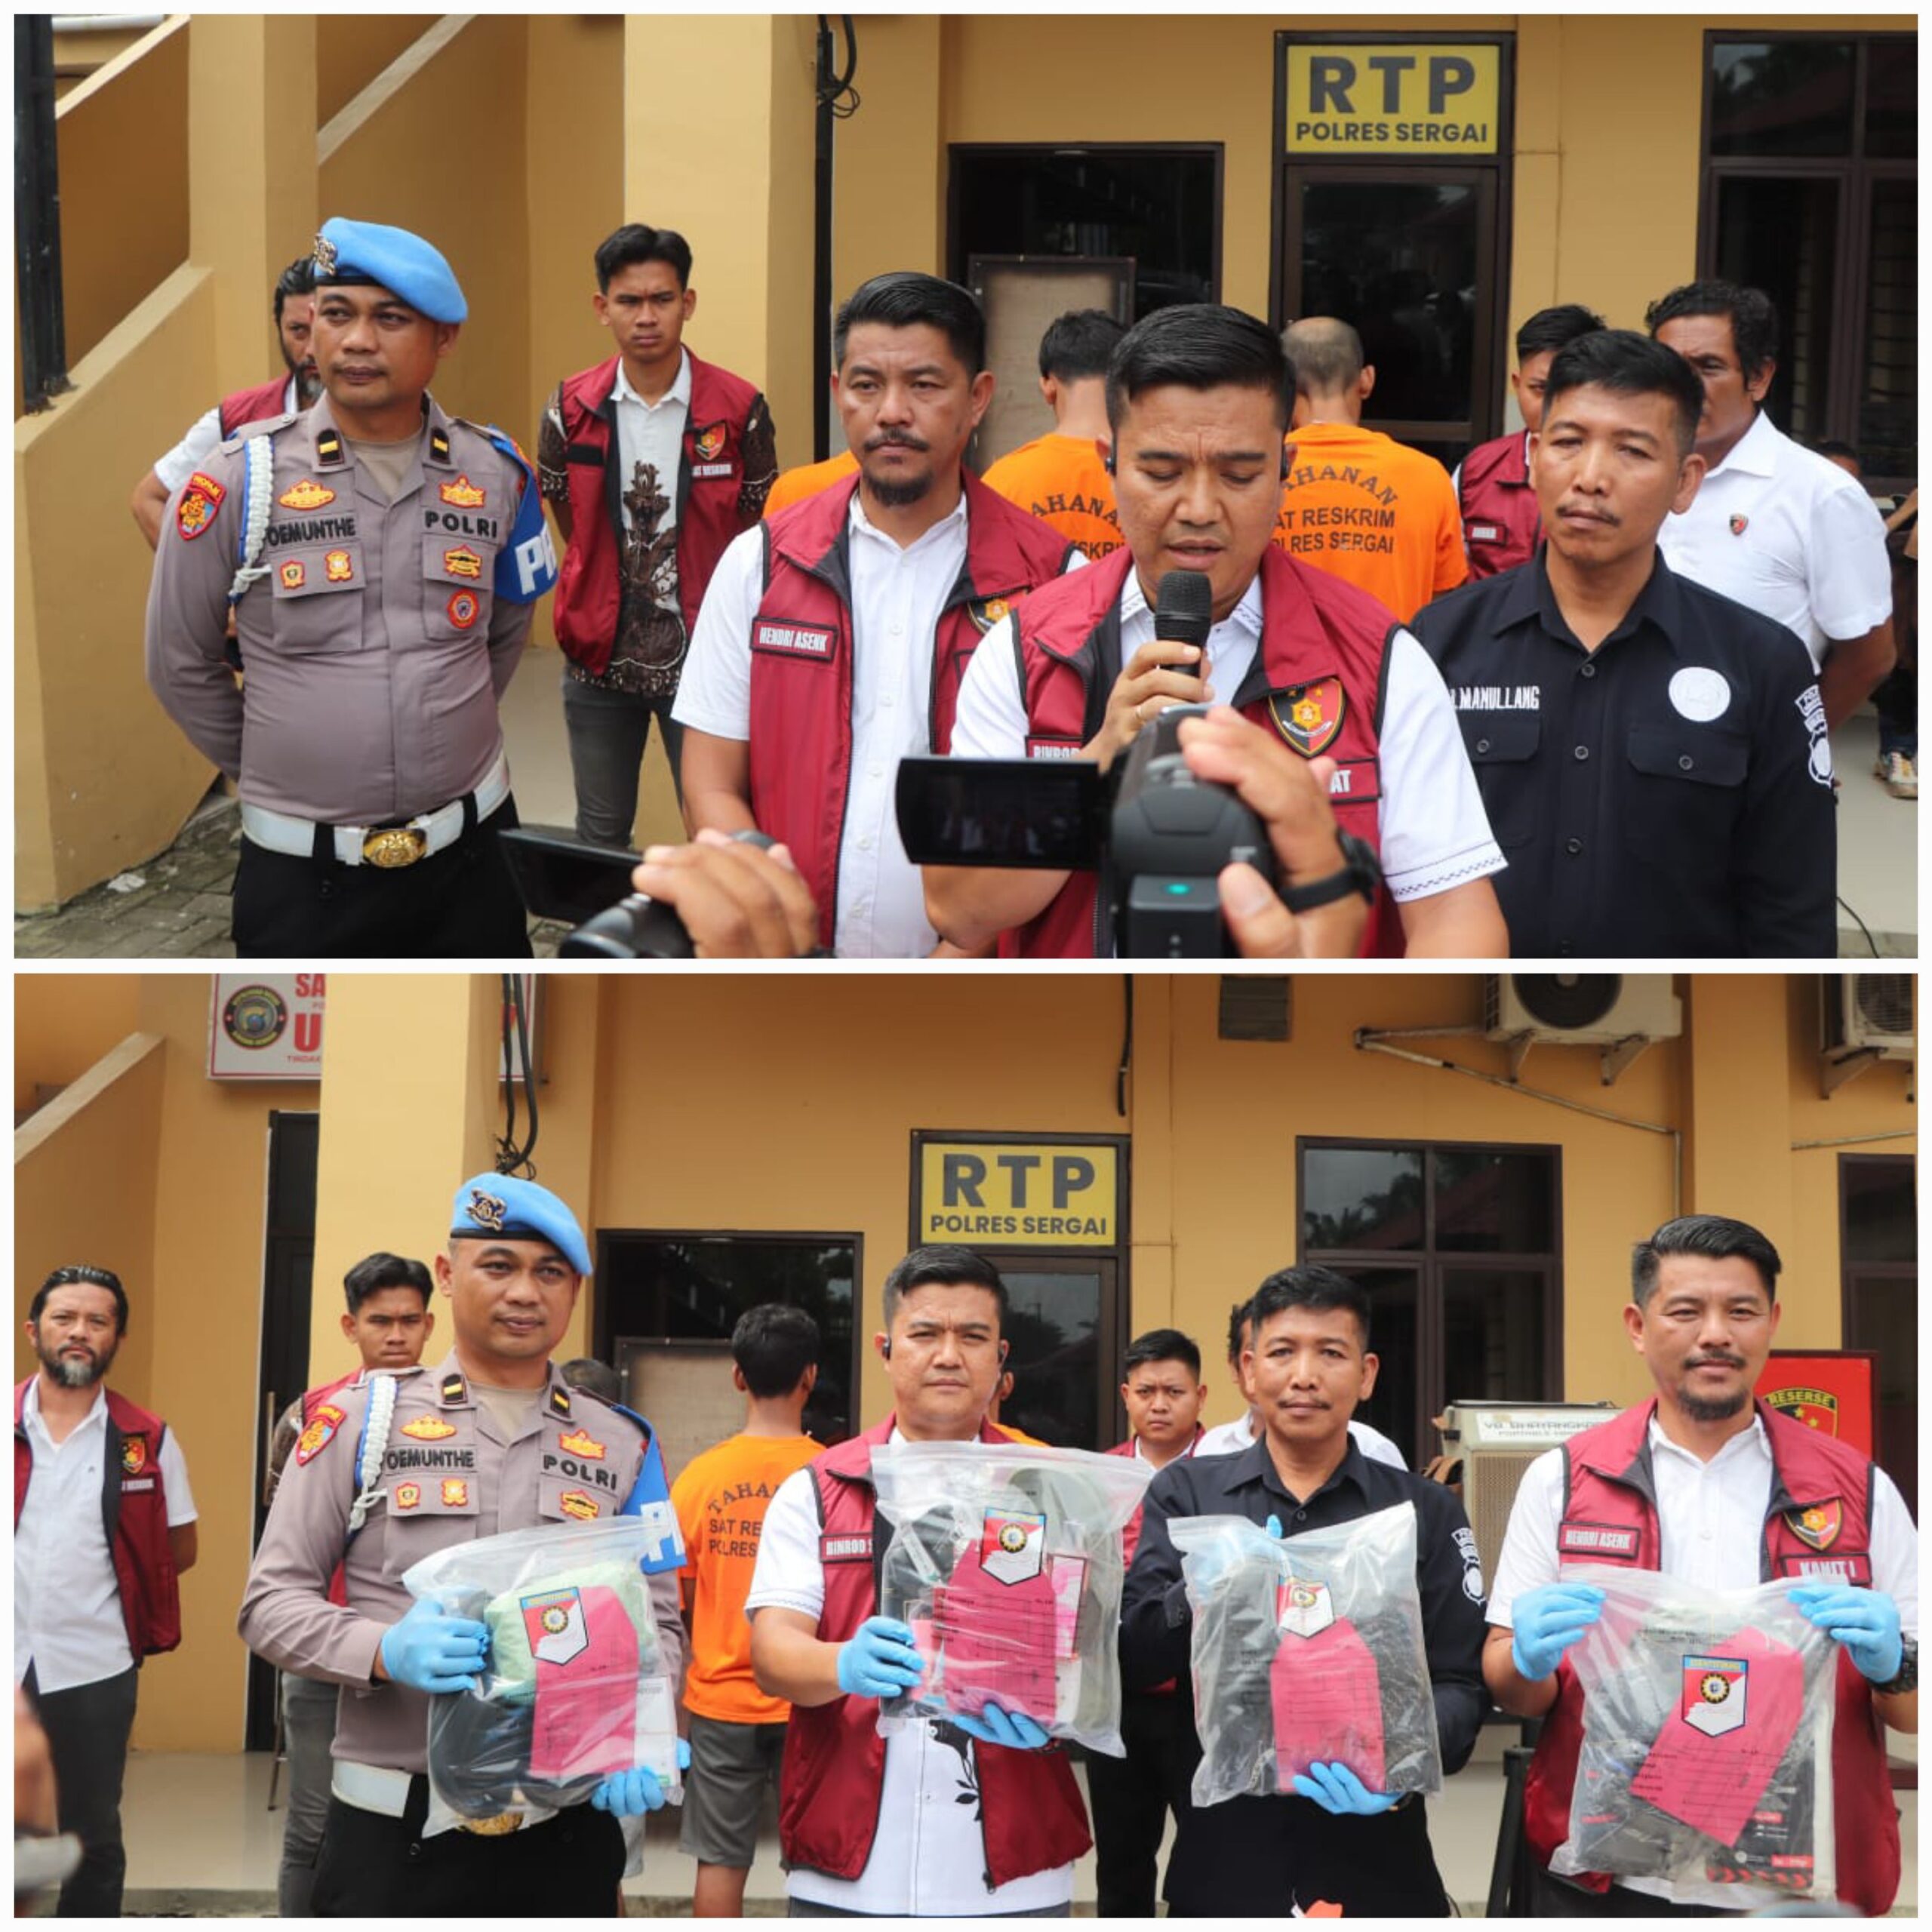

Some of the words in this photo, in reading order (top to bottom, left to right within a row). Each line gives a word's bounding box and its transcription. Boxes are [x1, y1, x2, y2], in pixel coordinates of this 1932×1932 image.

[1309, 56, 1475, 114] RTP
[1296, 122, 1389, 142] POLRES
[1395, 123, 1487, 142] SERGAI
[426, 510, 497, 538] POLRI
[1303, 506, 1395, 528] RESKRIM
[1329, 531, 1394, 554] SERGAI
[943, 1154, 1095, 1208] RTP
[931, 1215, 1017, 1233] POLRES
[1023, 1217, 1106, 1235] SERGAI
[1767, 1391, 1830, 1407] RESERSE
[543, 1454, 617, 1491] POLRI
[709, 1518, 737, 1534] SAT
